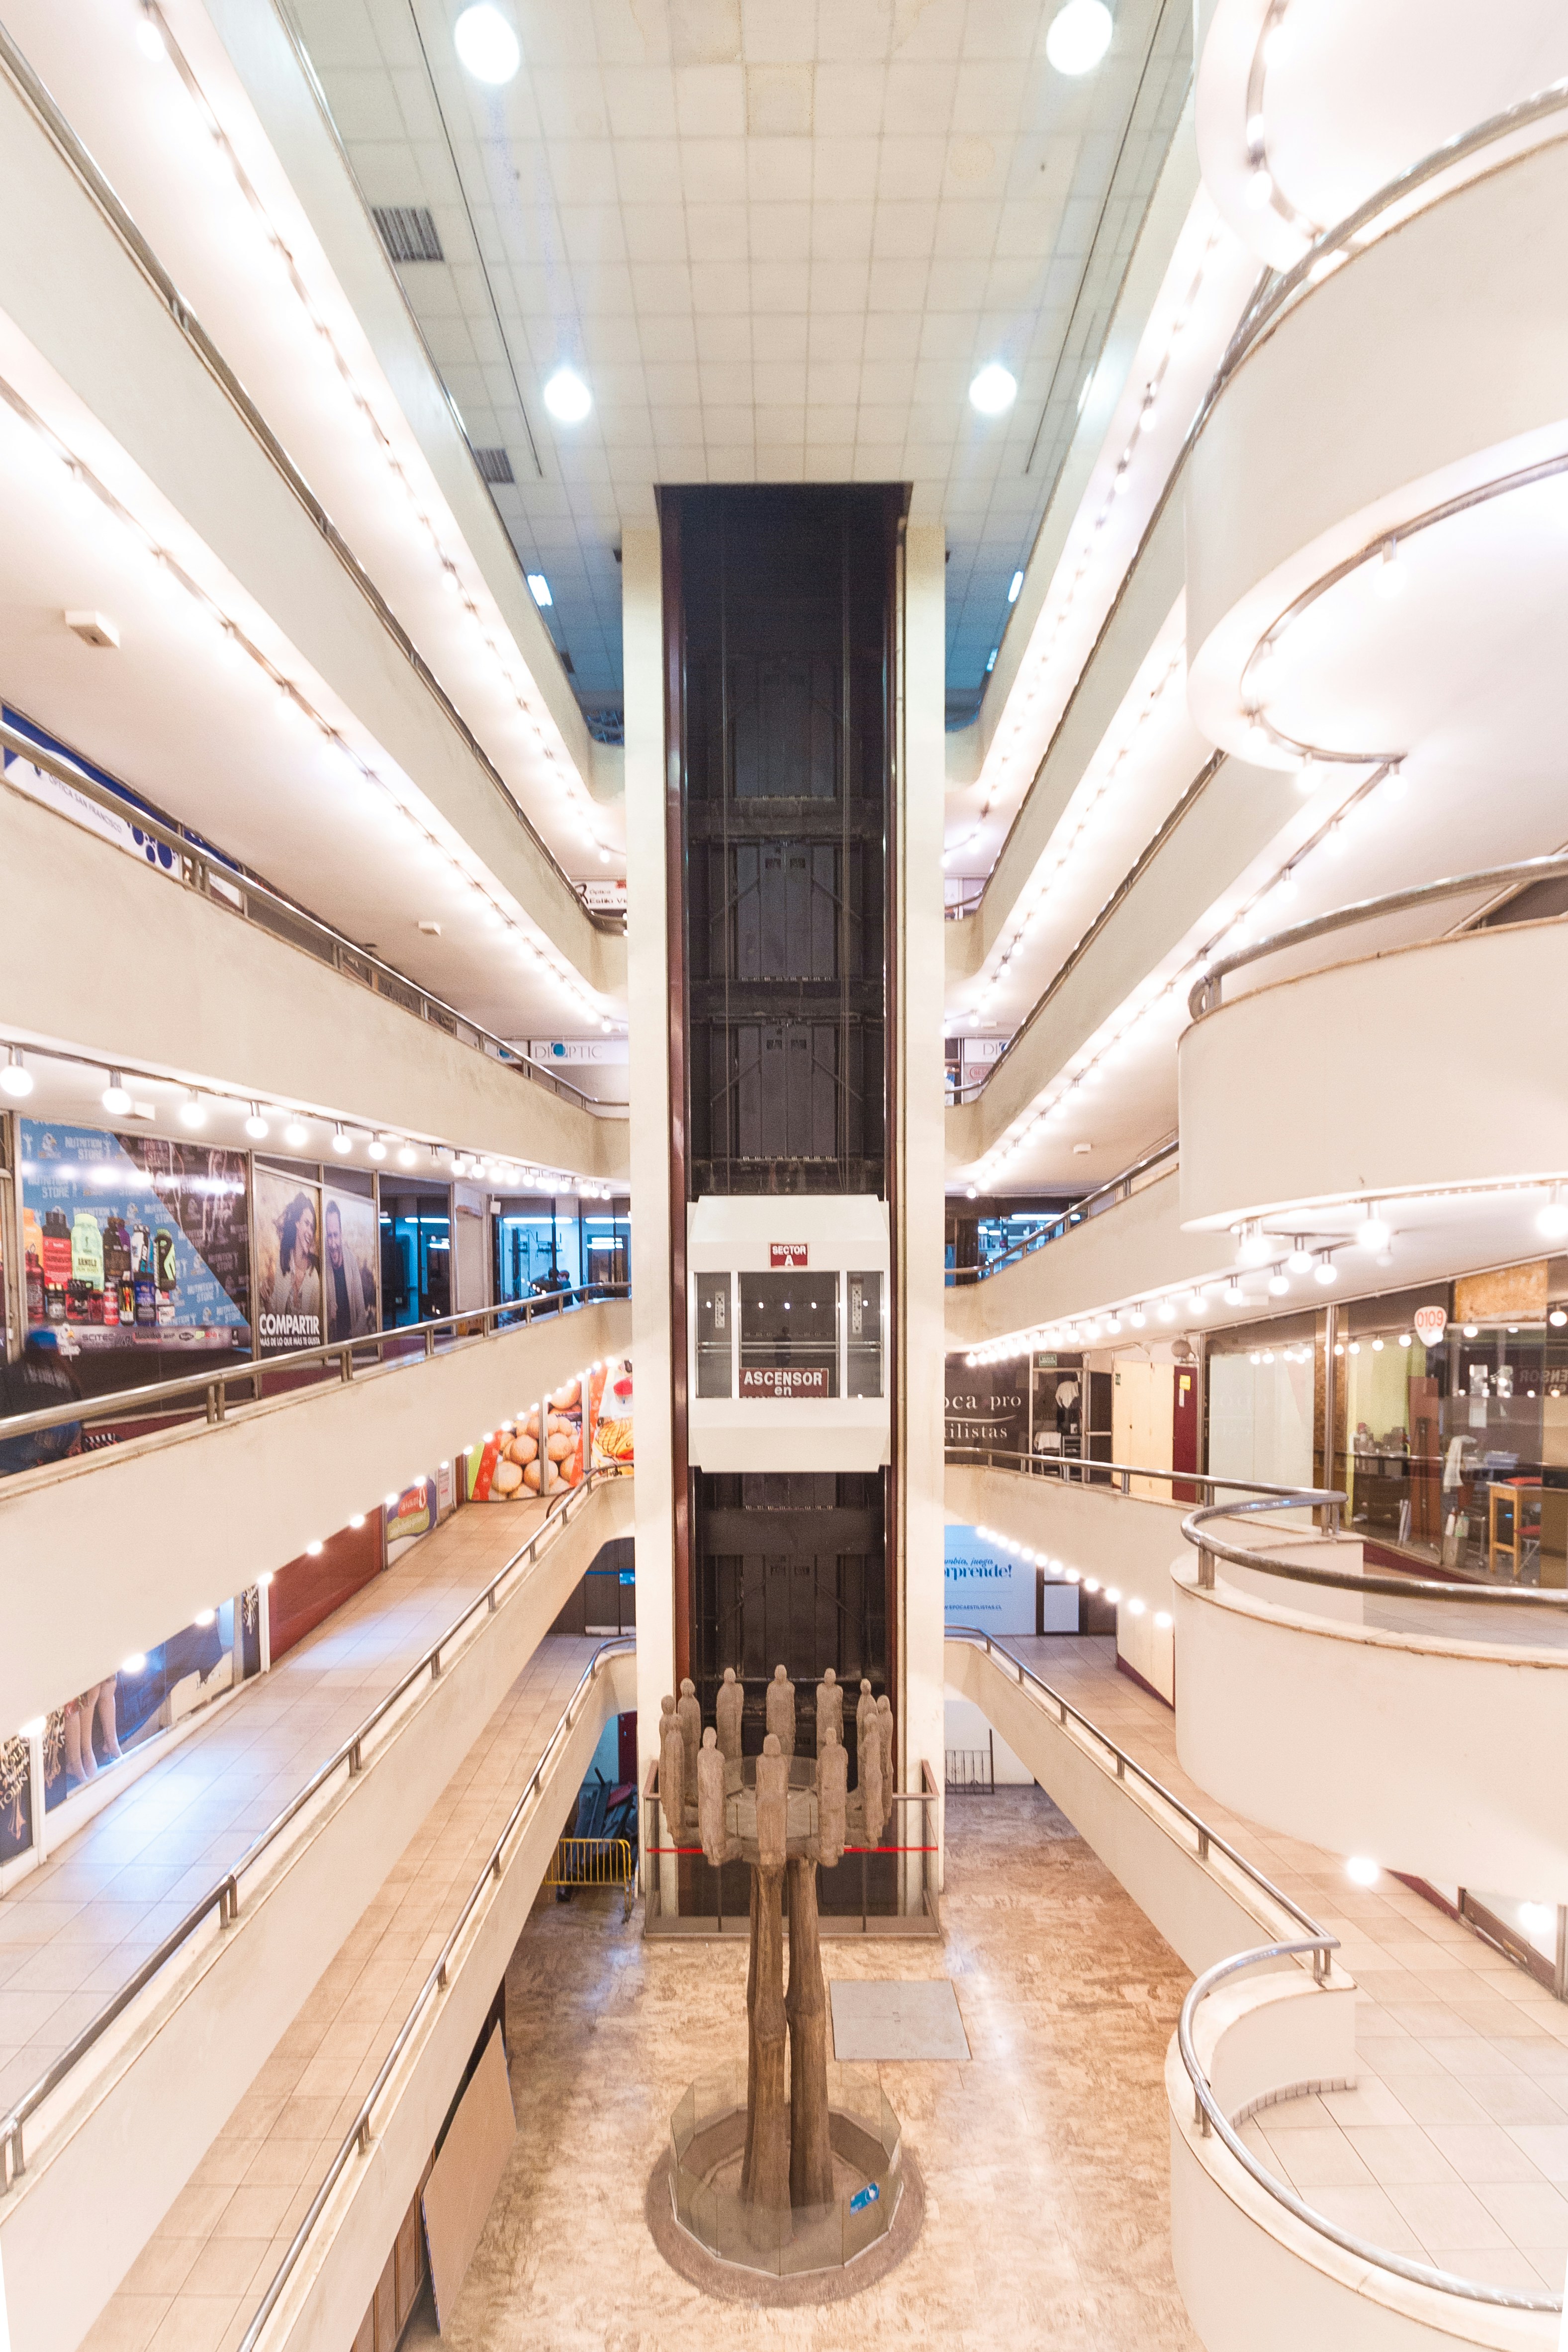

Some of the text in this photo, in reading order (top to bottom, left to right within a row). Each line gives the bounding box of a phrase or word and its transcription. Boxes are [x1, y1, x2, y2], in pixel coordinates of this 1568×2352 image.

[75, 794, 87, 808] SAN
[89, 803, 122, 834] FRANCISCO
[772, 1245, 806, 1255] SECTOR
[785, 1254, 794, 1266] A
[259, 1314, 320, 1335] COMPARTIR
[1417, 1311, 1443, 1327] 0109
[271, 1337, 277, 1347] DE
[277, 1336, 283, 1346] LO
[283, 1336, 292, 1346] QUE
[743, 1371, 823, 1386] ASCENSOR
[774, 1386, 792, 1396] en
[990, 1396, 1021, 1411] pro
[970, 1557, 994, 1568] juega
[944, 1564, 1012, 1580] rprende!
